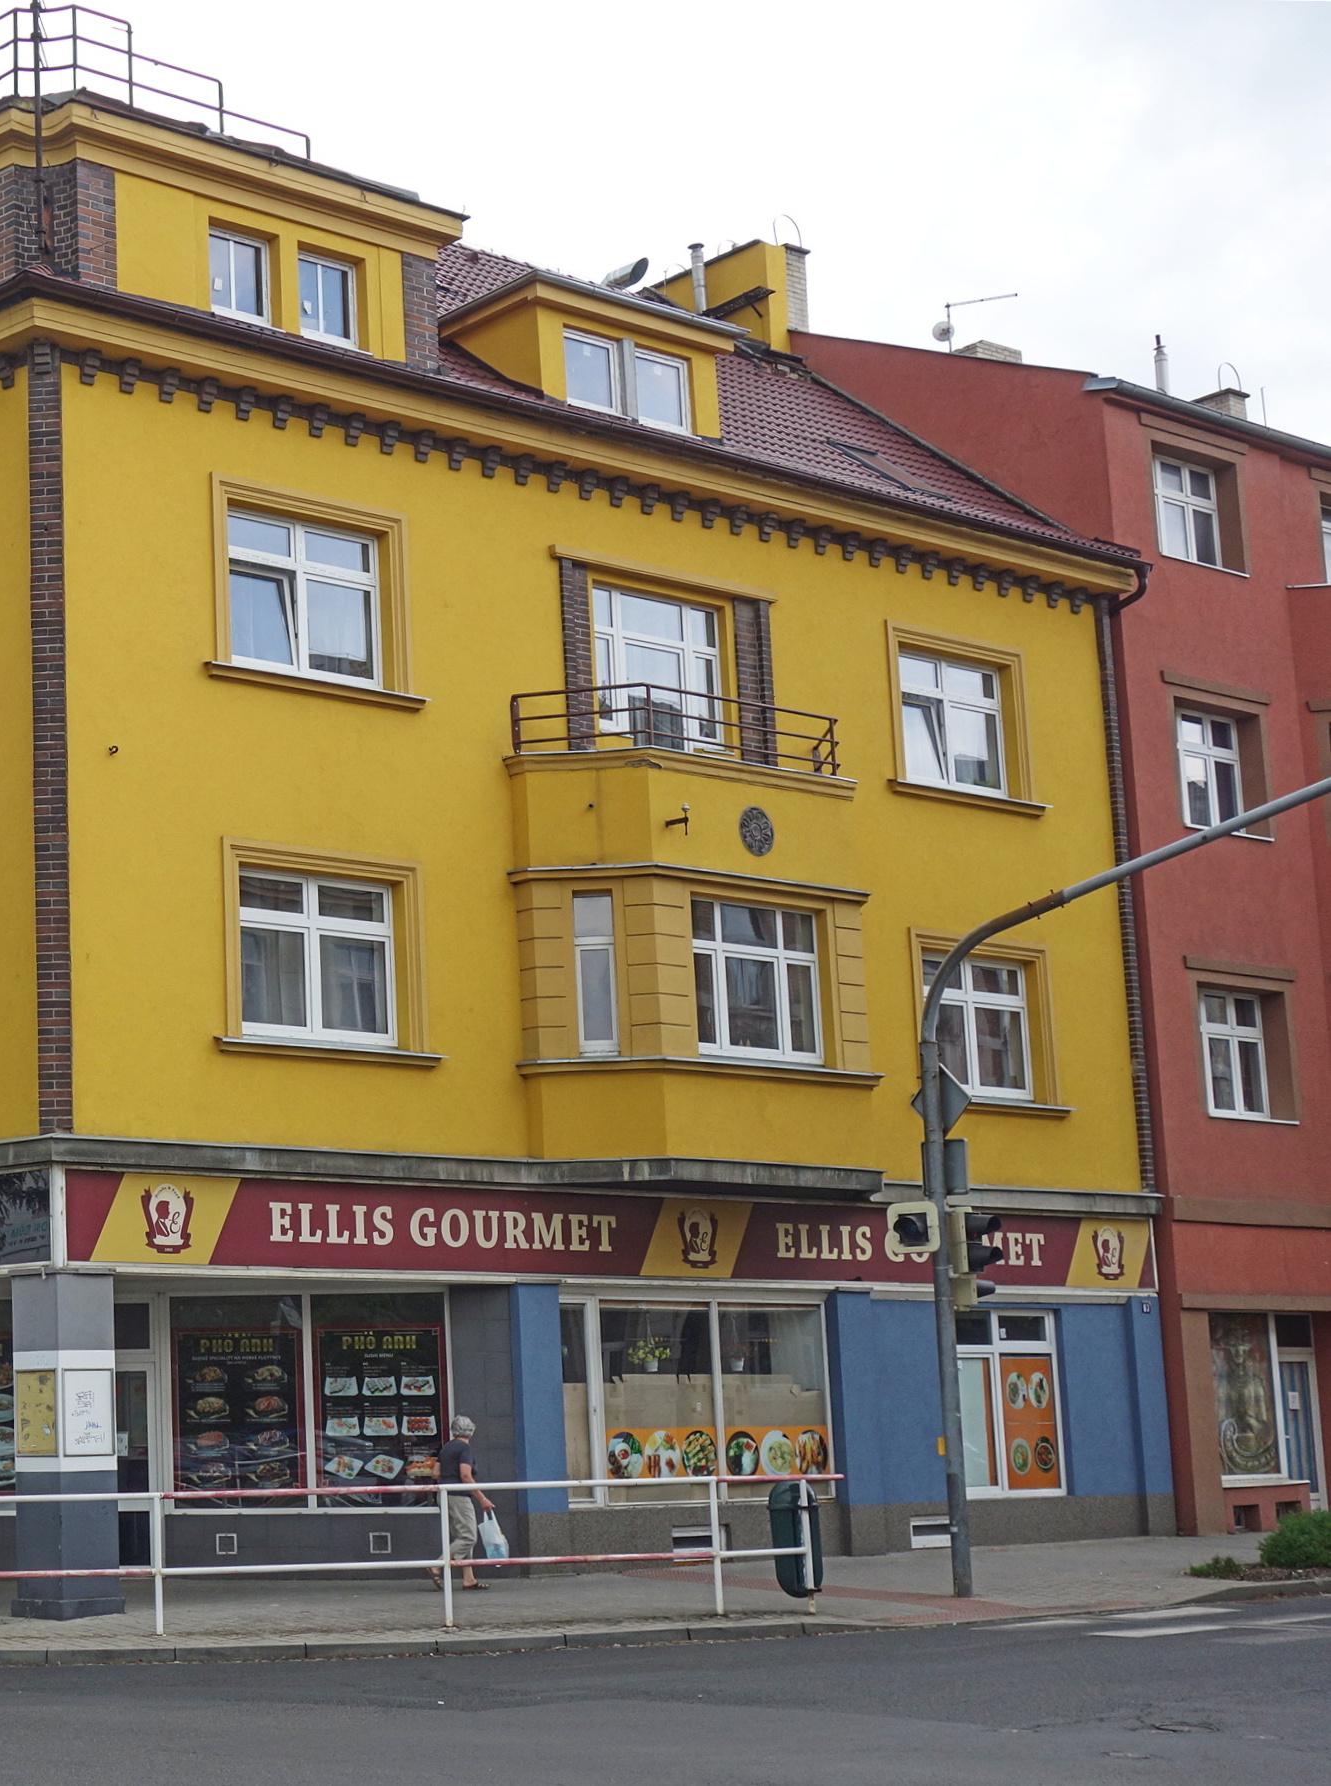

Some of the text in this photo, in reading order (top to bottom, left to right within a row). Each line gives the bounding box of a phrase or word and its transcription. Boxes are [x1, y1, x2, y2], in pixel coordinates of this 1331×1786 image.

[269, 1201, 617, 1253] ELLIS GOURMET
[775, 1222, 873, 1262] ELLIS
